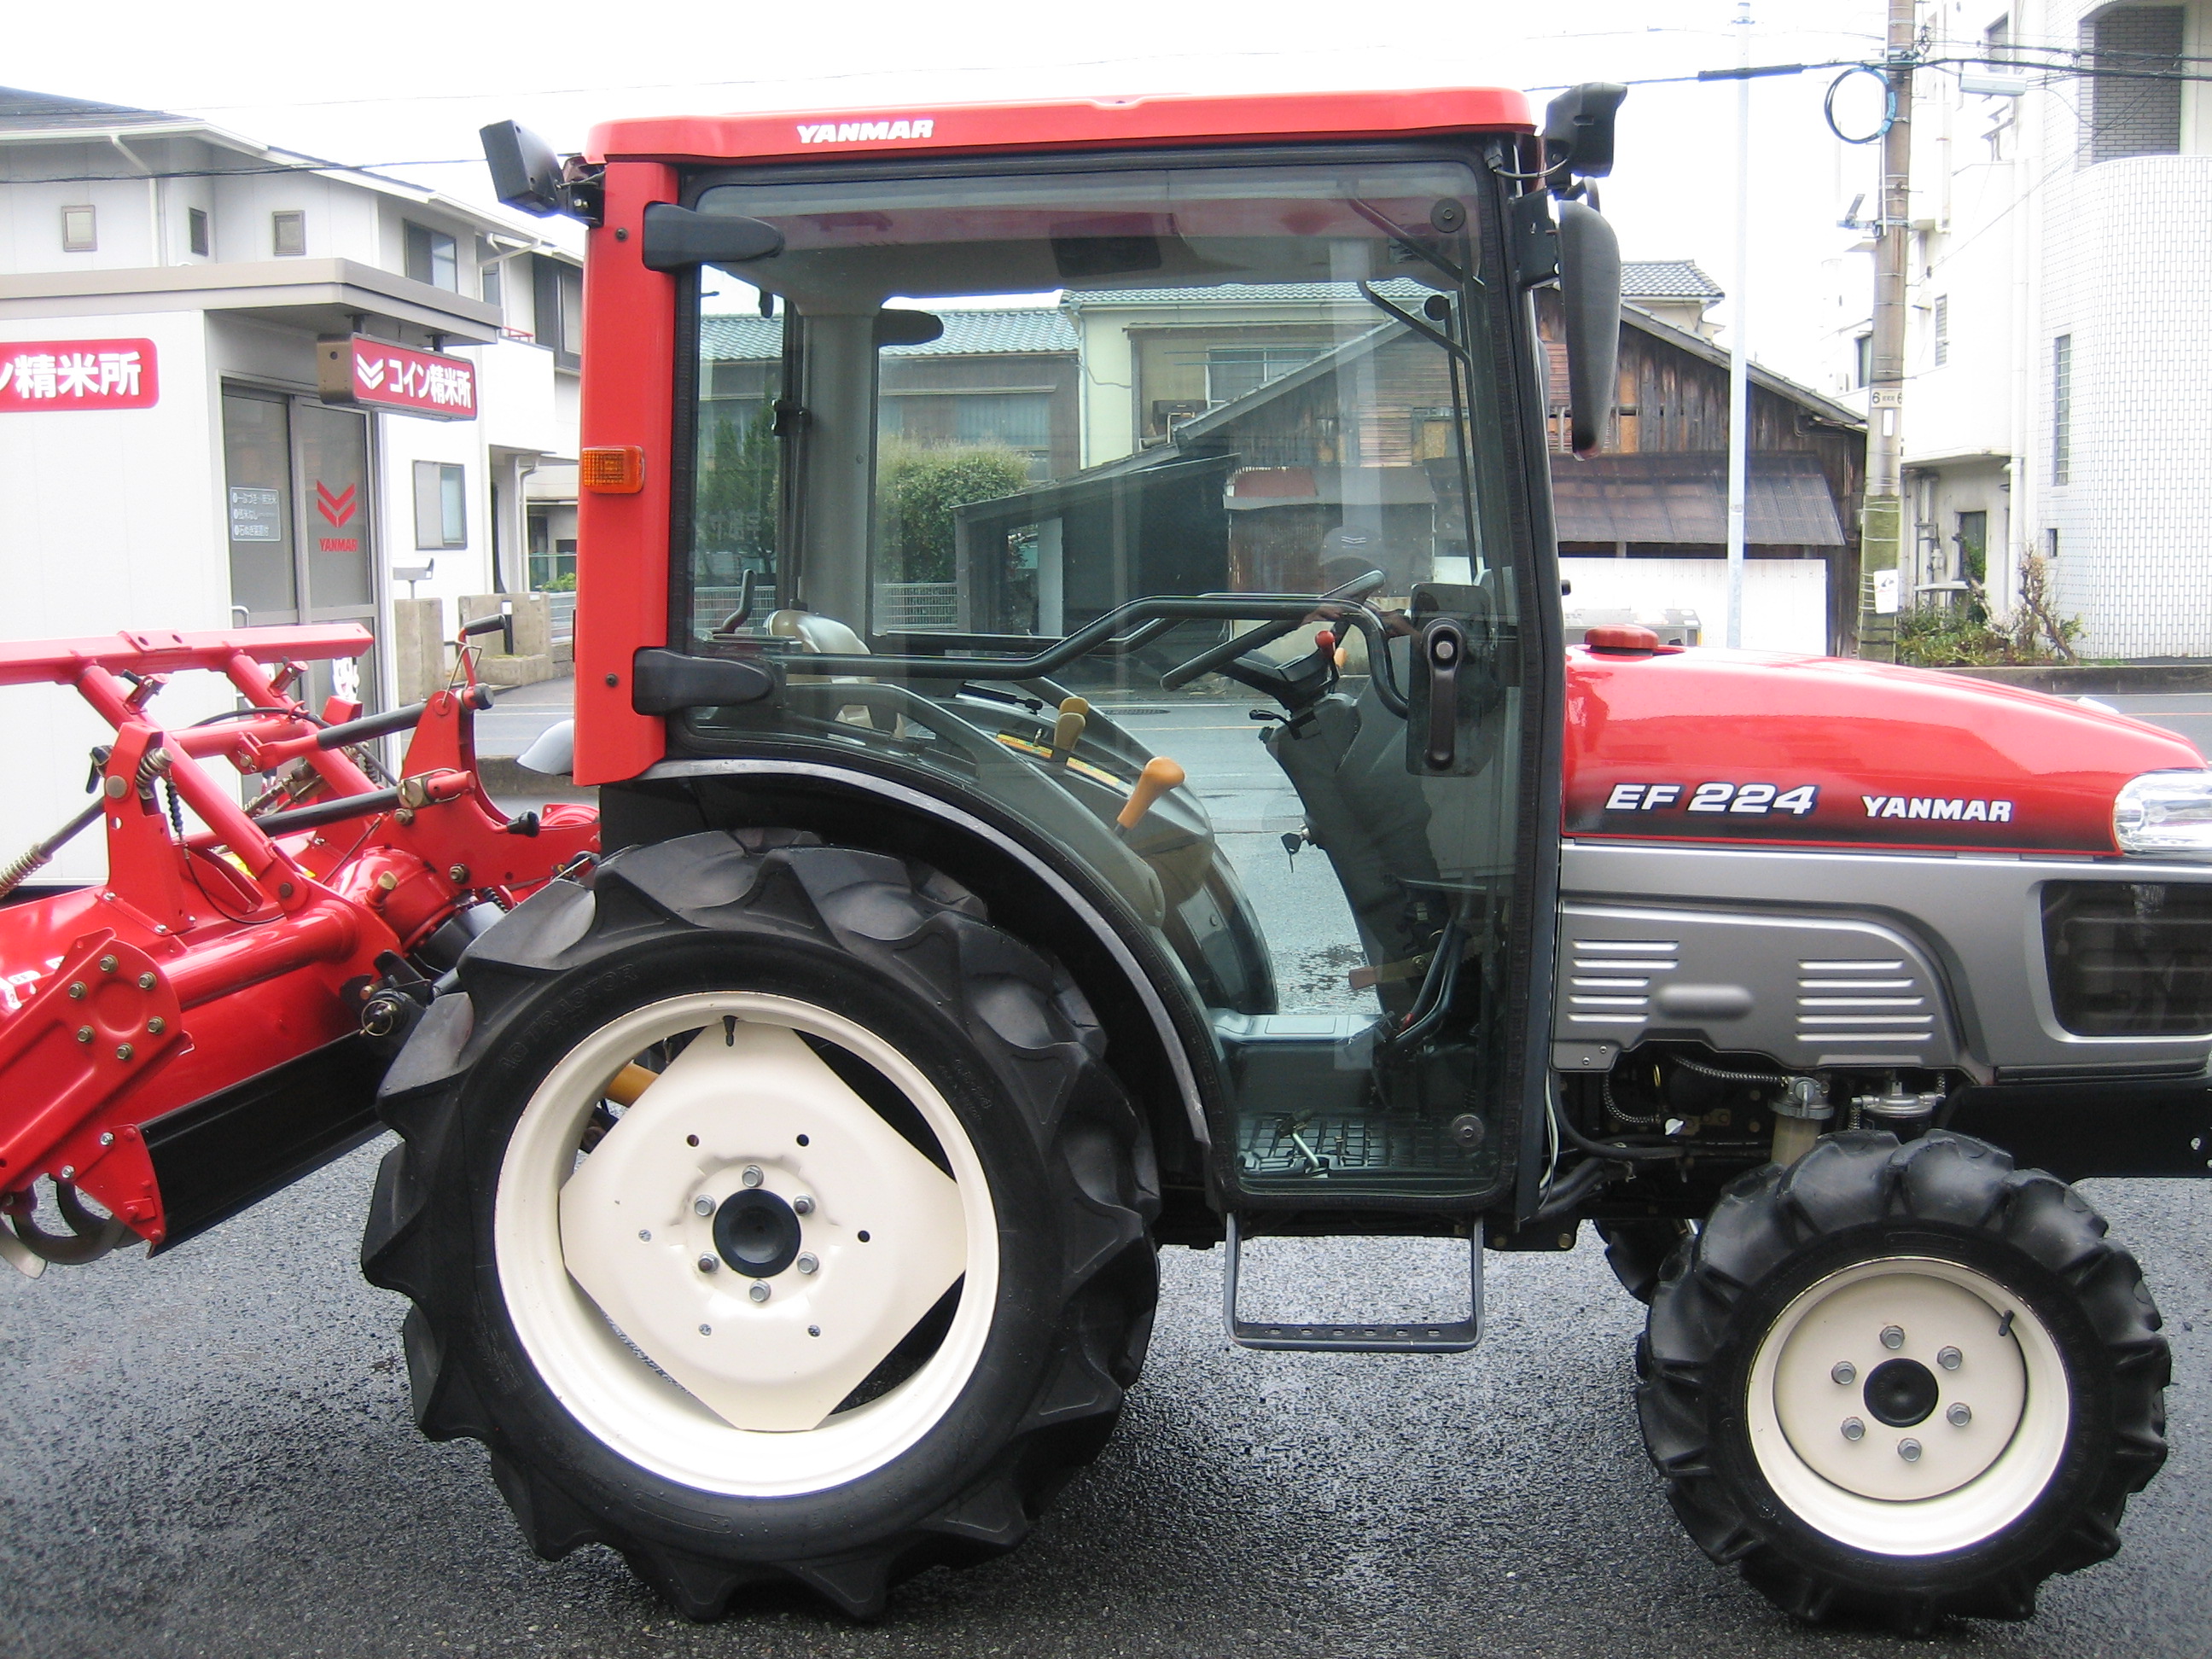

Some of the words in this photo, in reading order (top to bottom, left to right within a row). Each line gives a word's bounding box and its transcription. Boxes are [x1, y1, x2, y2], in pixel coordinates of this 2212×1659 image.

[796, 119, 934, 144] YANMAR
[388, 358, 472, 410] コイン精米所
[318, 538, 358, 552] YANMAR
[1604, 783, 1682, 812] EF
[1685, 782, 1819, 816] 224
[1860, 795, 2013, 824] YANMAR
